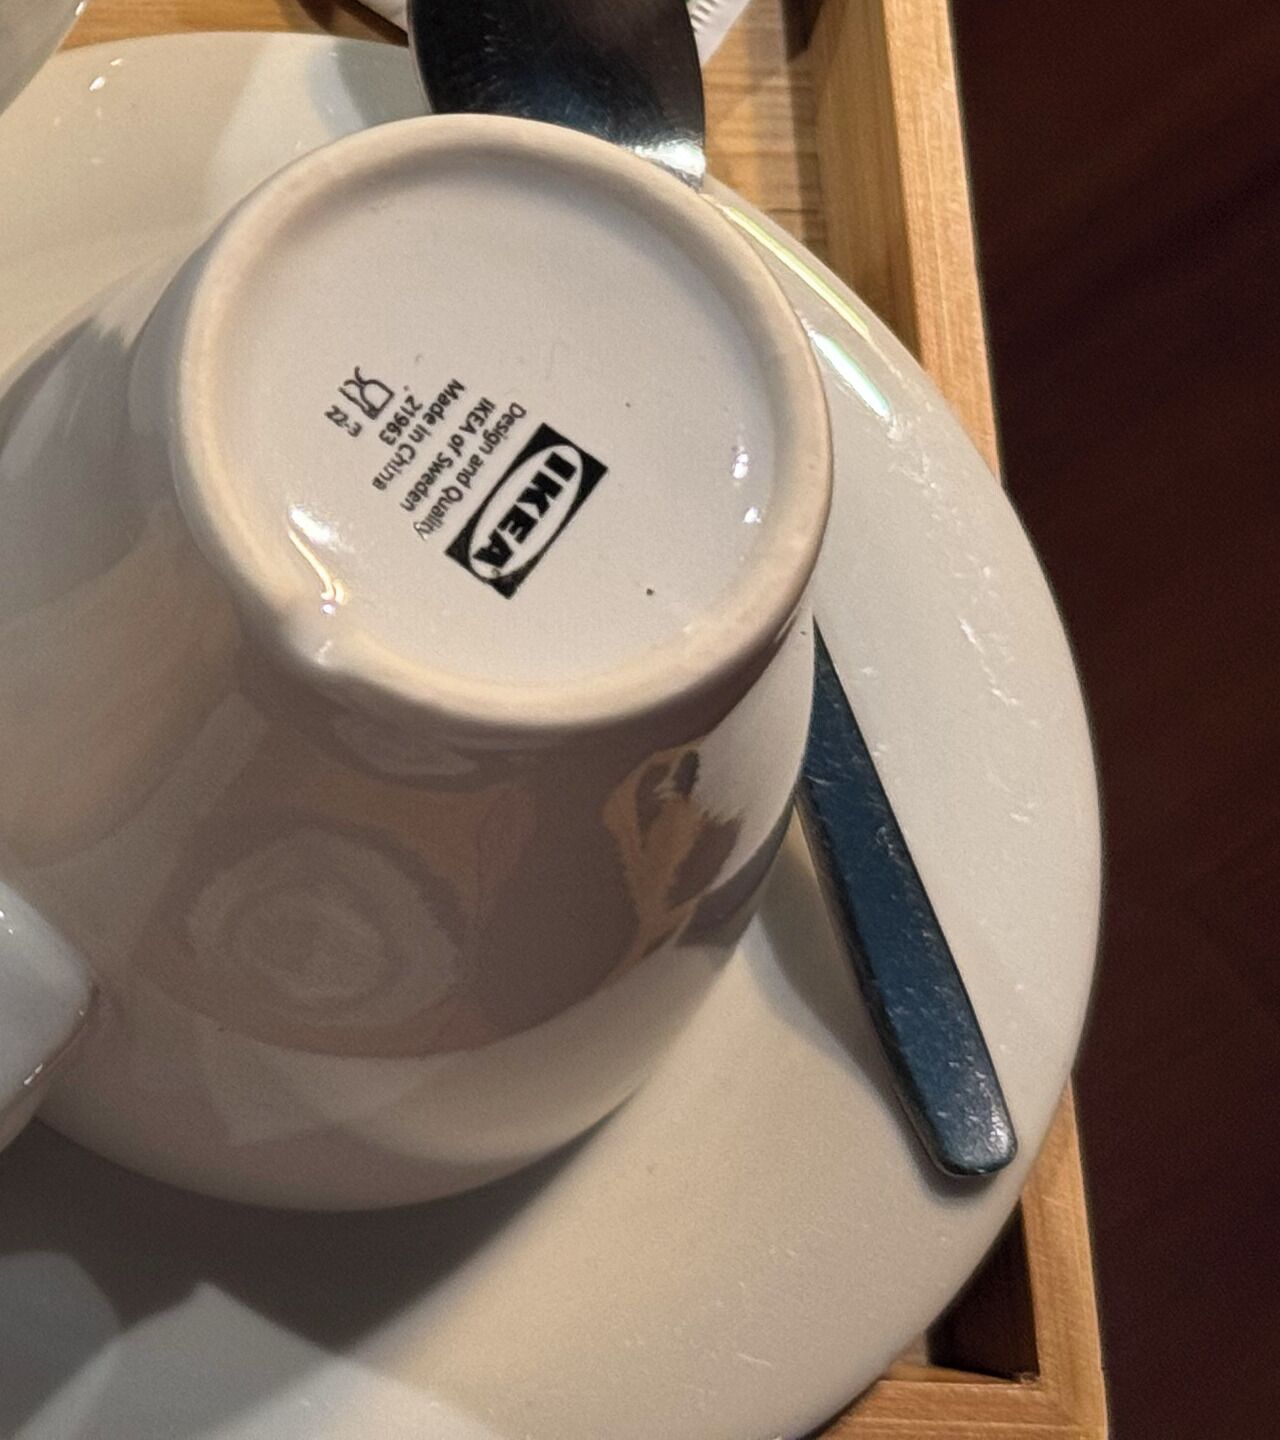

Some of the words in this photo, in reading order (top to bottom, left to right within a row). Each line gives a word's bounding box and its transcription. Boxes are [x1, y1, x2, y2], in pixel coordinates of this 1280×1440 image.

[378, 395, 424, 446] 21963
[422, 378, 466, 426] Made
[459, 396, 497, 436] IKEA
[407, 424, 432, 443] in
[447, 433, 466, 457] of
[478, 402, 528, 456] Design
[372, 443, 417, 491] China
[400, 452, 455, 512] Sweden
[456, 454, 484, 490] and
[413, 485, 464, 541] Quality
[472, 451, 578, 568] IKEA
